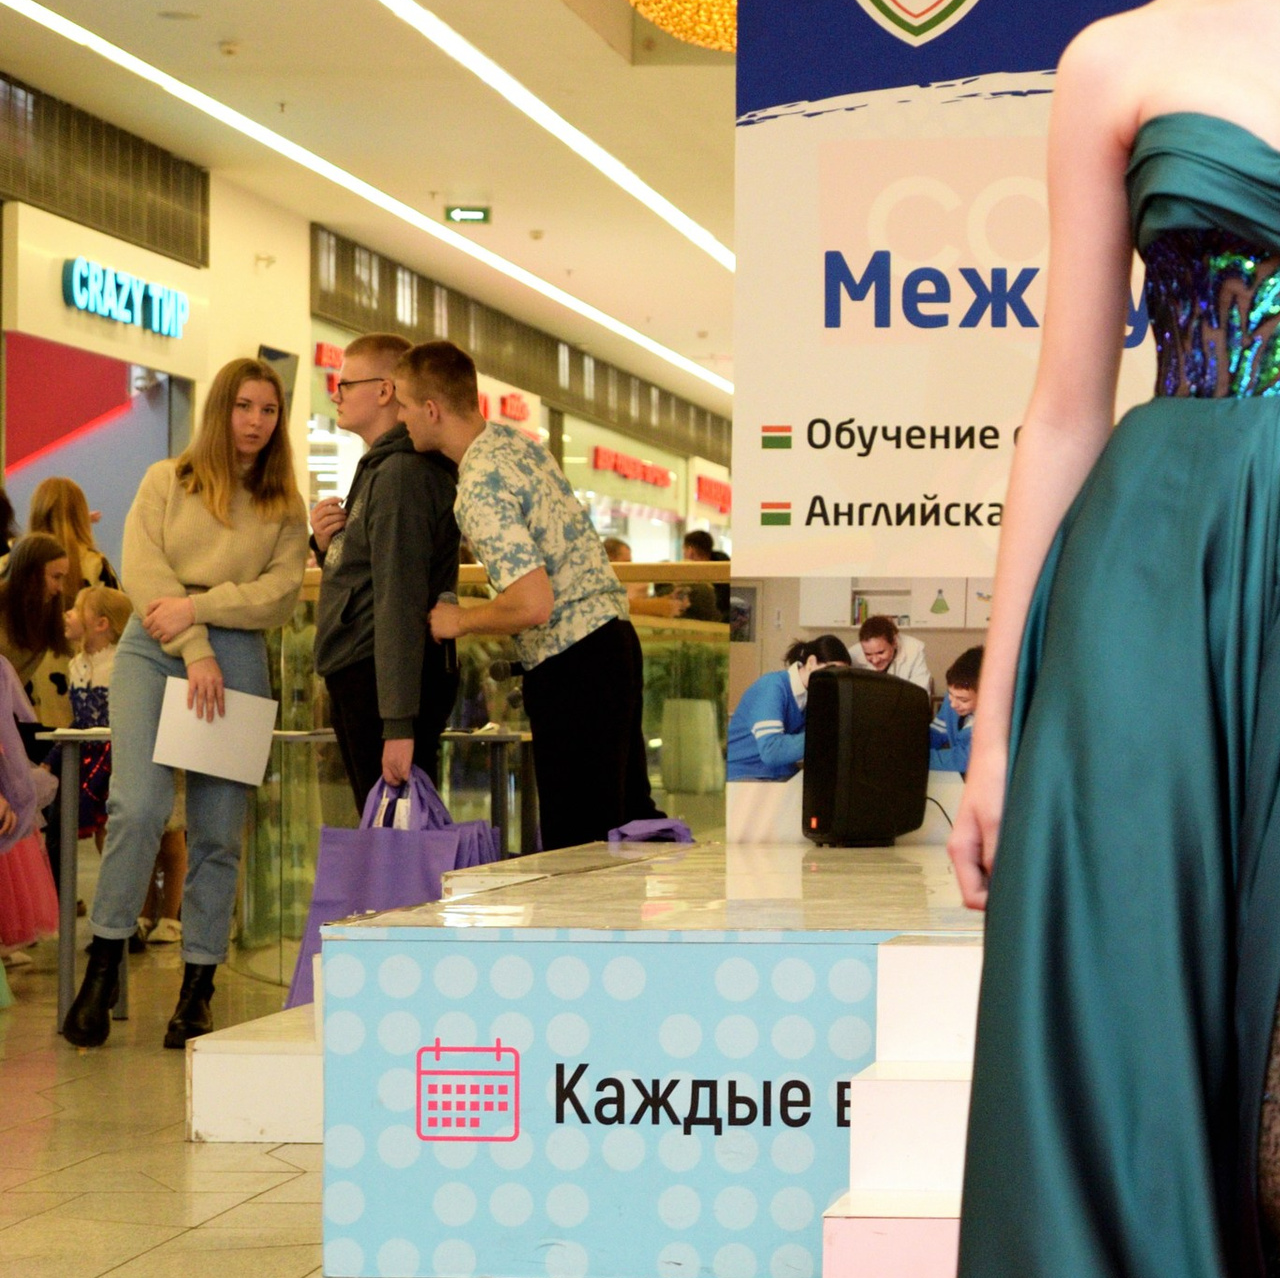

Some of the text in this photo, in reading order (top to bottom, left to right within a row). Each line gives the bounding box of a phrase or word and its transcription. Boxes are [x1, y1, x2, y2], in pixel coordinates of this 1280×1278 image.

[72, 255, 190, 339] CRAZY ТИР
[807, 417, 1000, 458] Обучение
[804, 493, 1004, 527] Английска
[555, 1063, 811, 1136] Каждые
